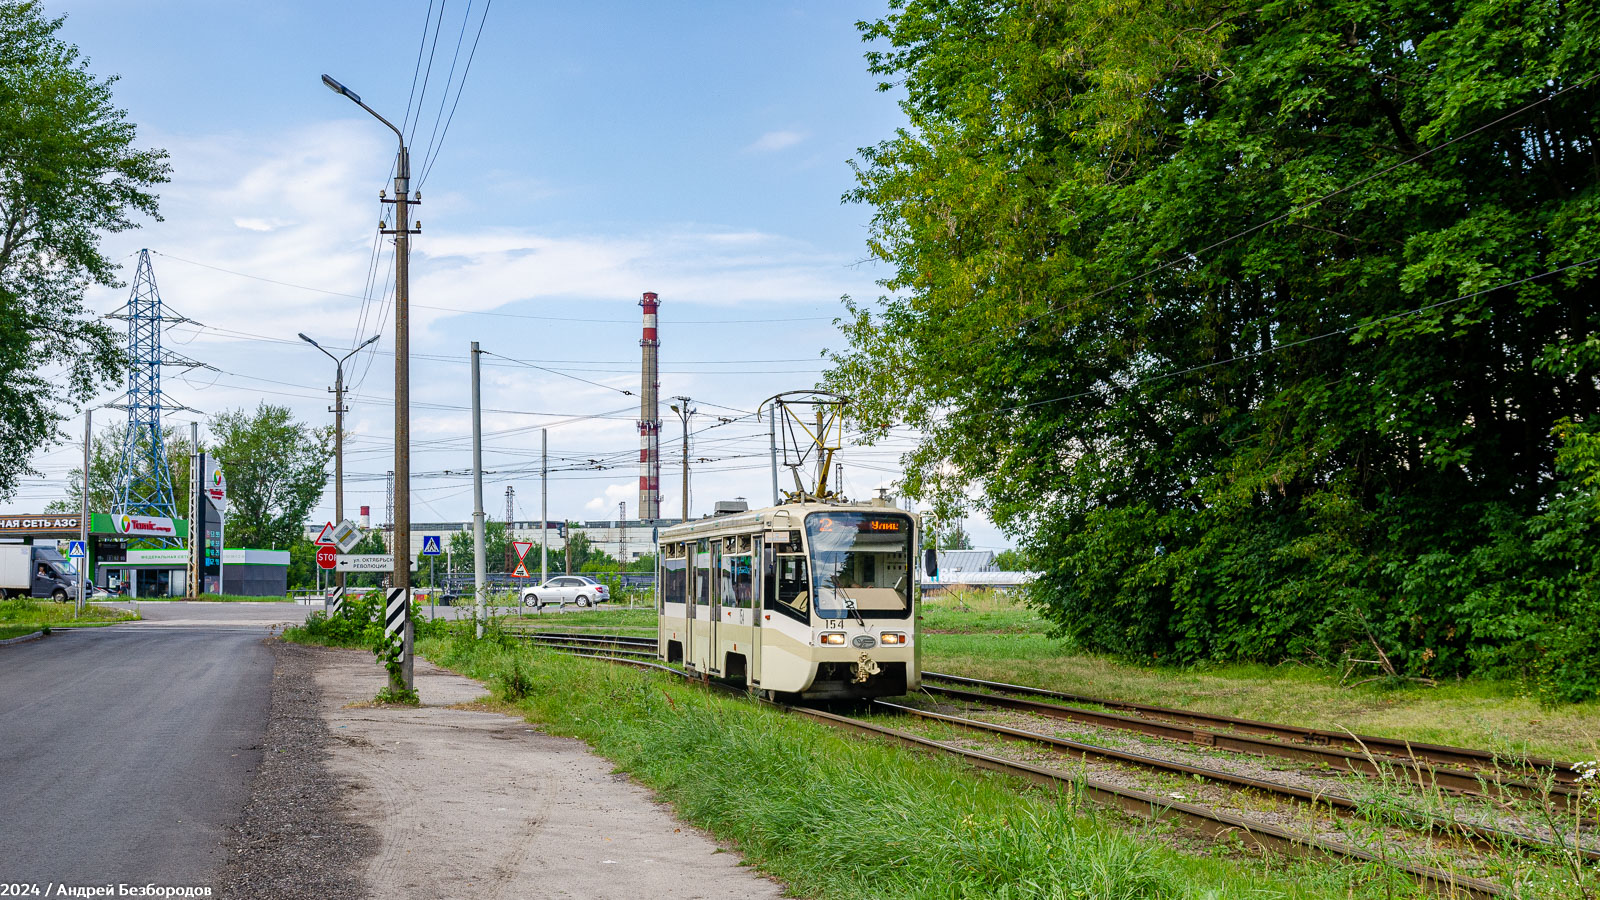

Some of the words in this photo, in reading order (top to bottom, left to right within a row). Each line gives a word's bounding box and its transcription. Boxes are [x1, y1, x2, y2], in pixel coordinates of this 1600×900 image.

[22, 519, 51, 527] СЕТЬ
[53, 518, 77, 527] АЗС
[819, 518, 833, 532] 2
[825, 620, 844, 629] 154
